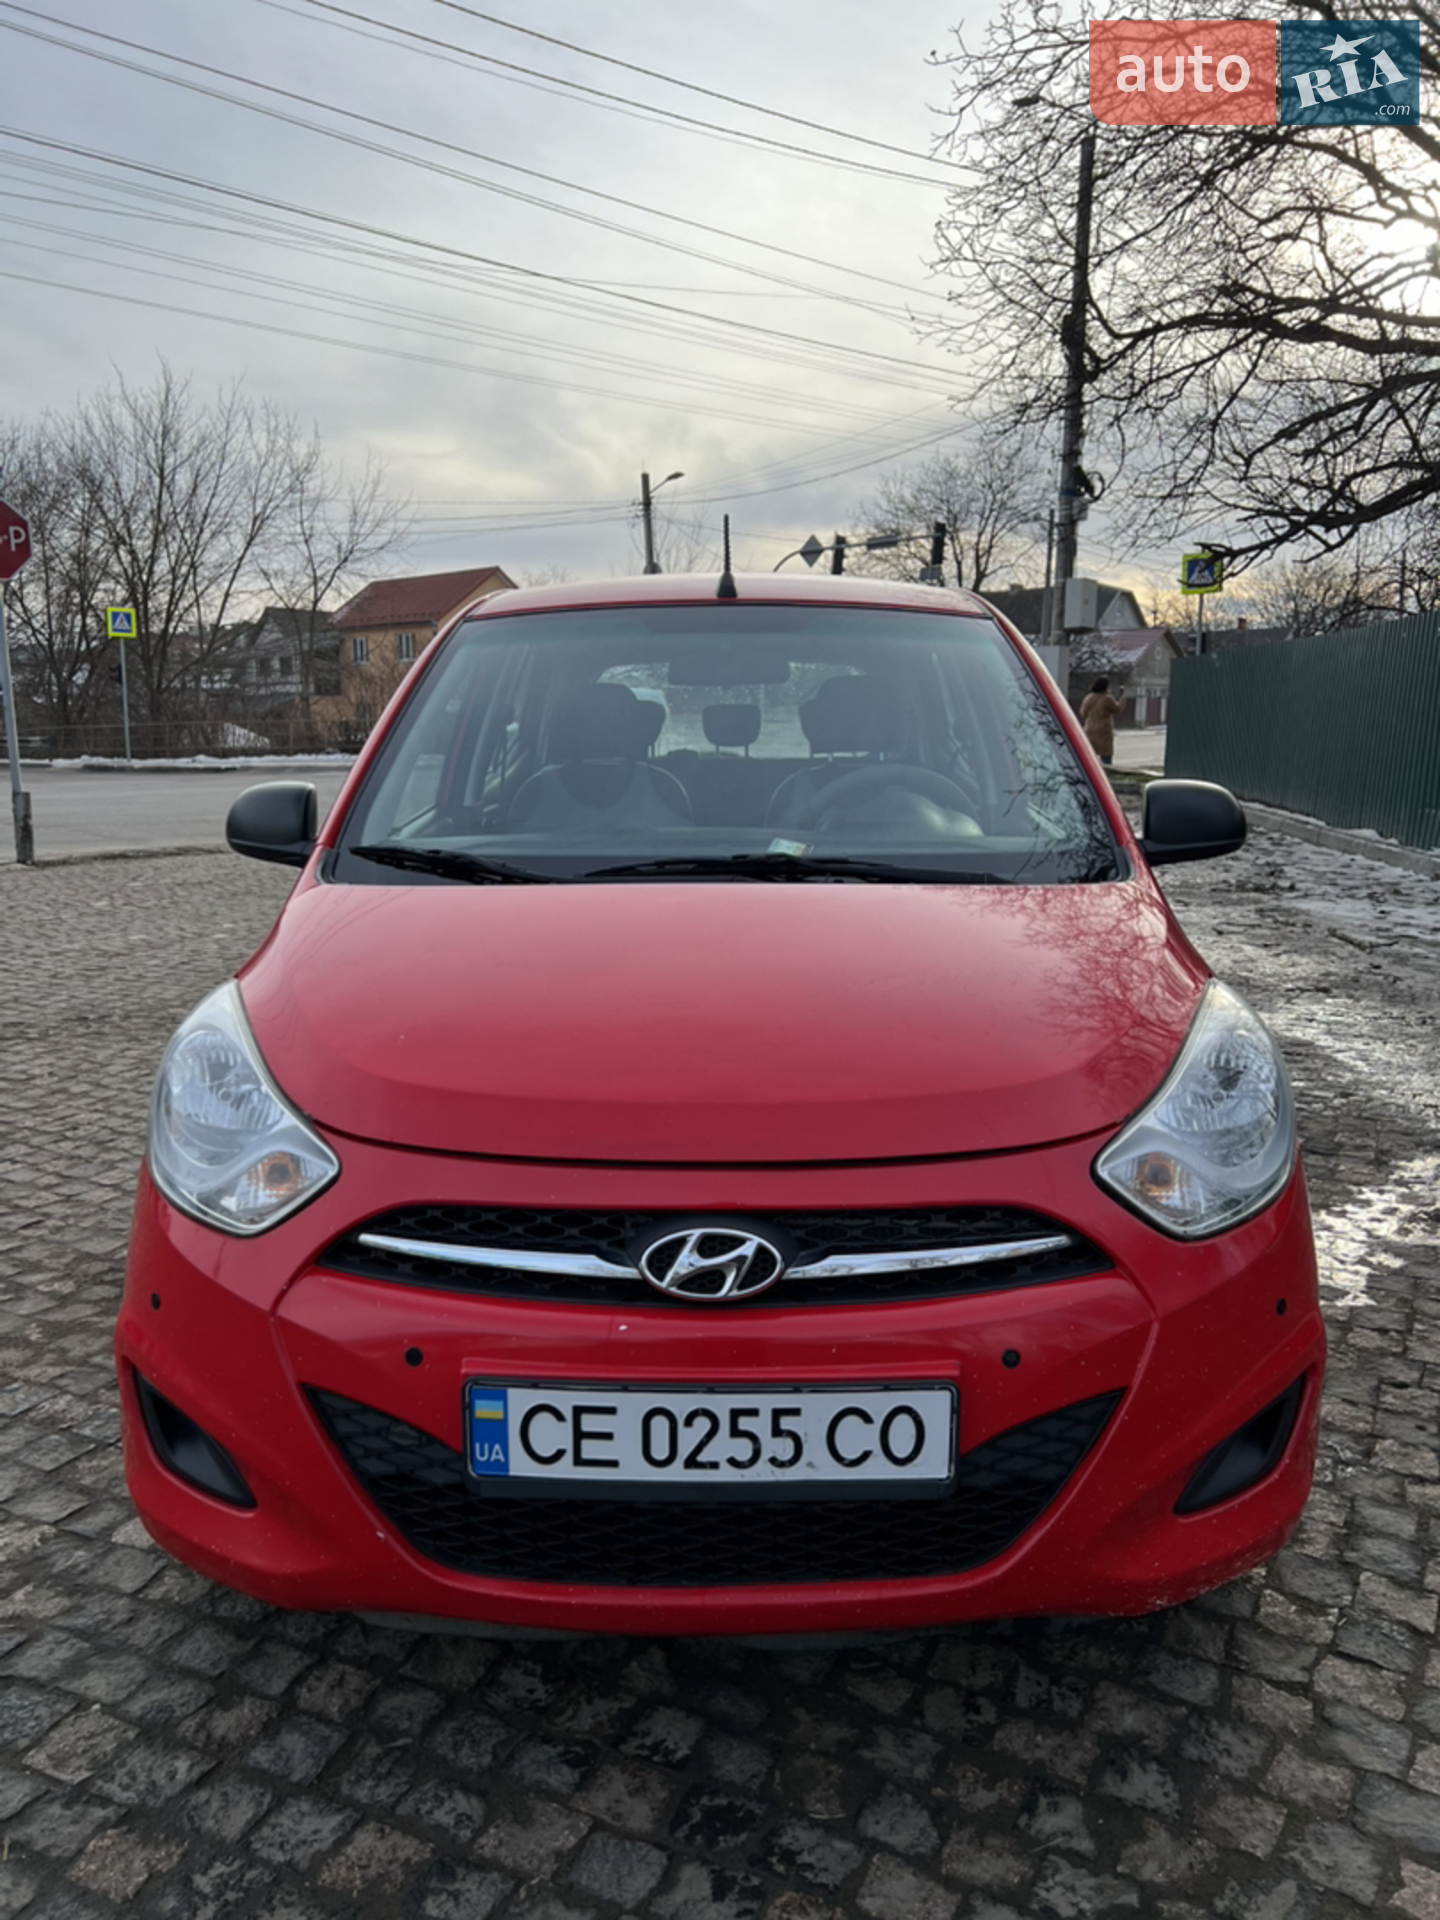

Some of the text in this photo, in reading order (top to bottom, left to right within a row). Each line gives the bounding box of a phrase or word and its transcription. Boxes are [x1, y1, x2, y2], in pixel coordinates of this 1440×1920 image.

[0, 526, 26, 552] P
[519, 1403, 927, 1470] CE 0255 CO
[475, 1442, 506, 1463] UA
